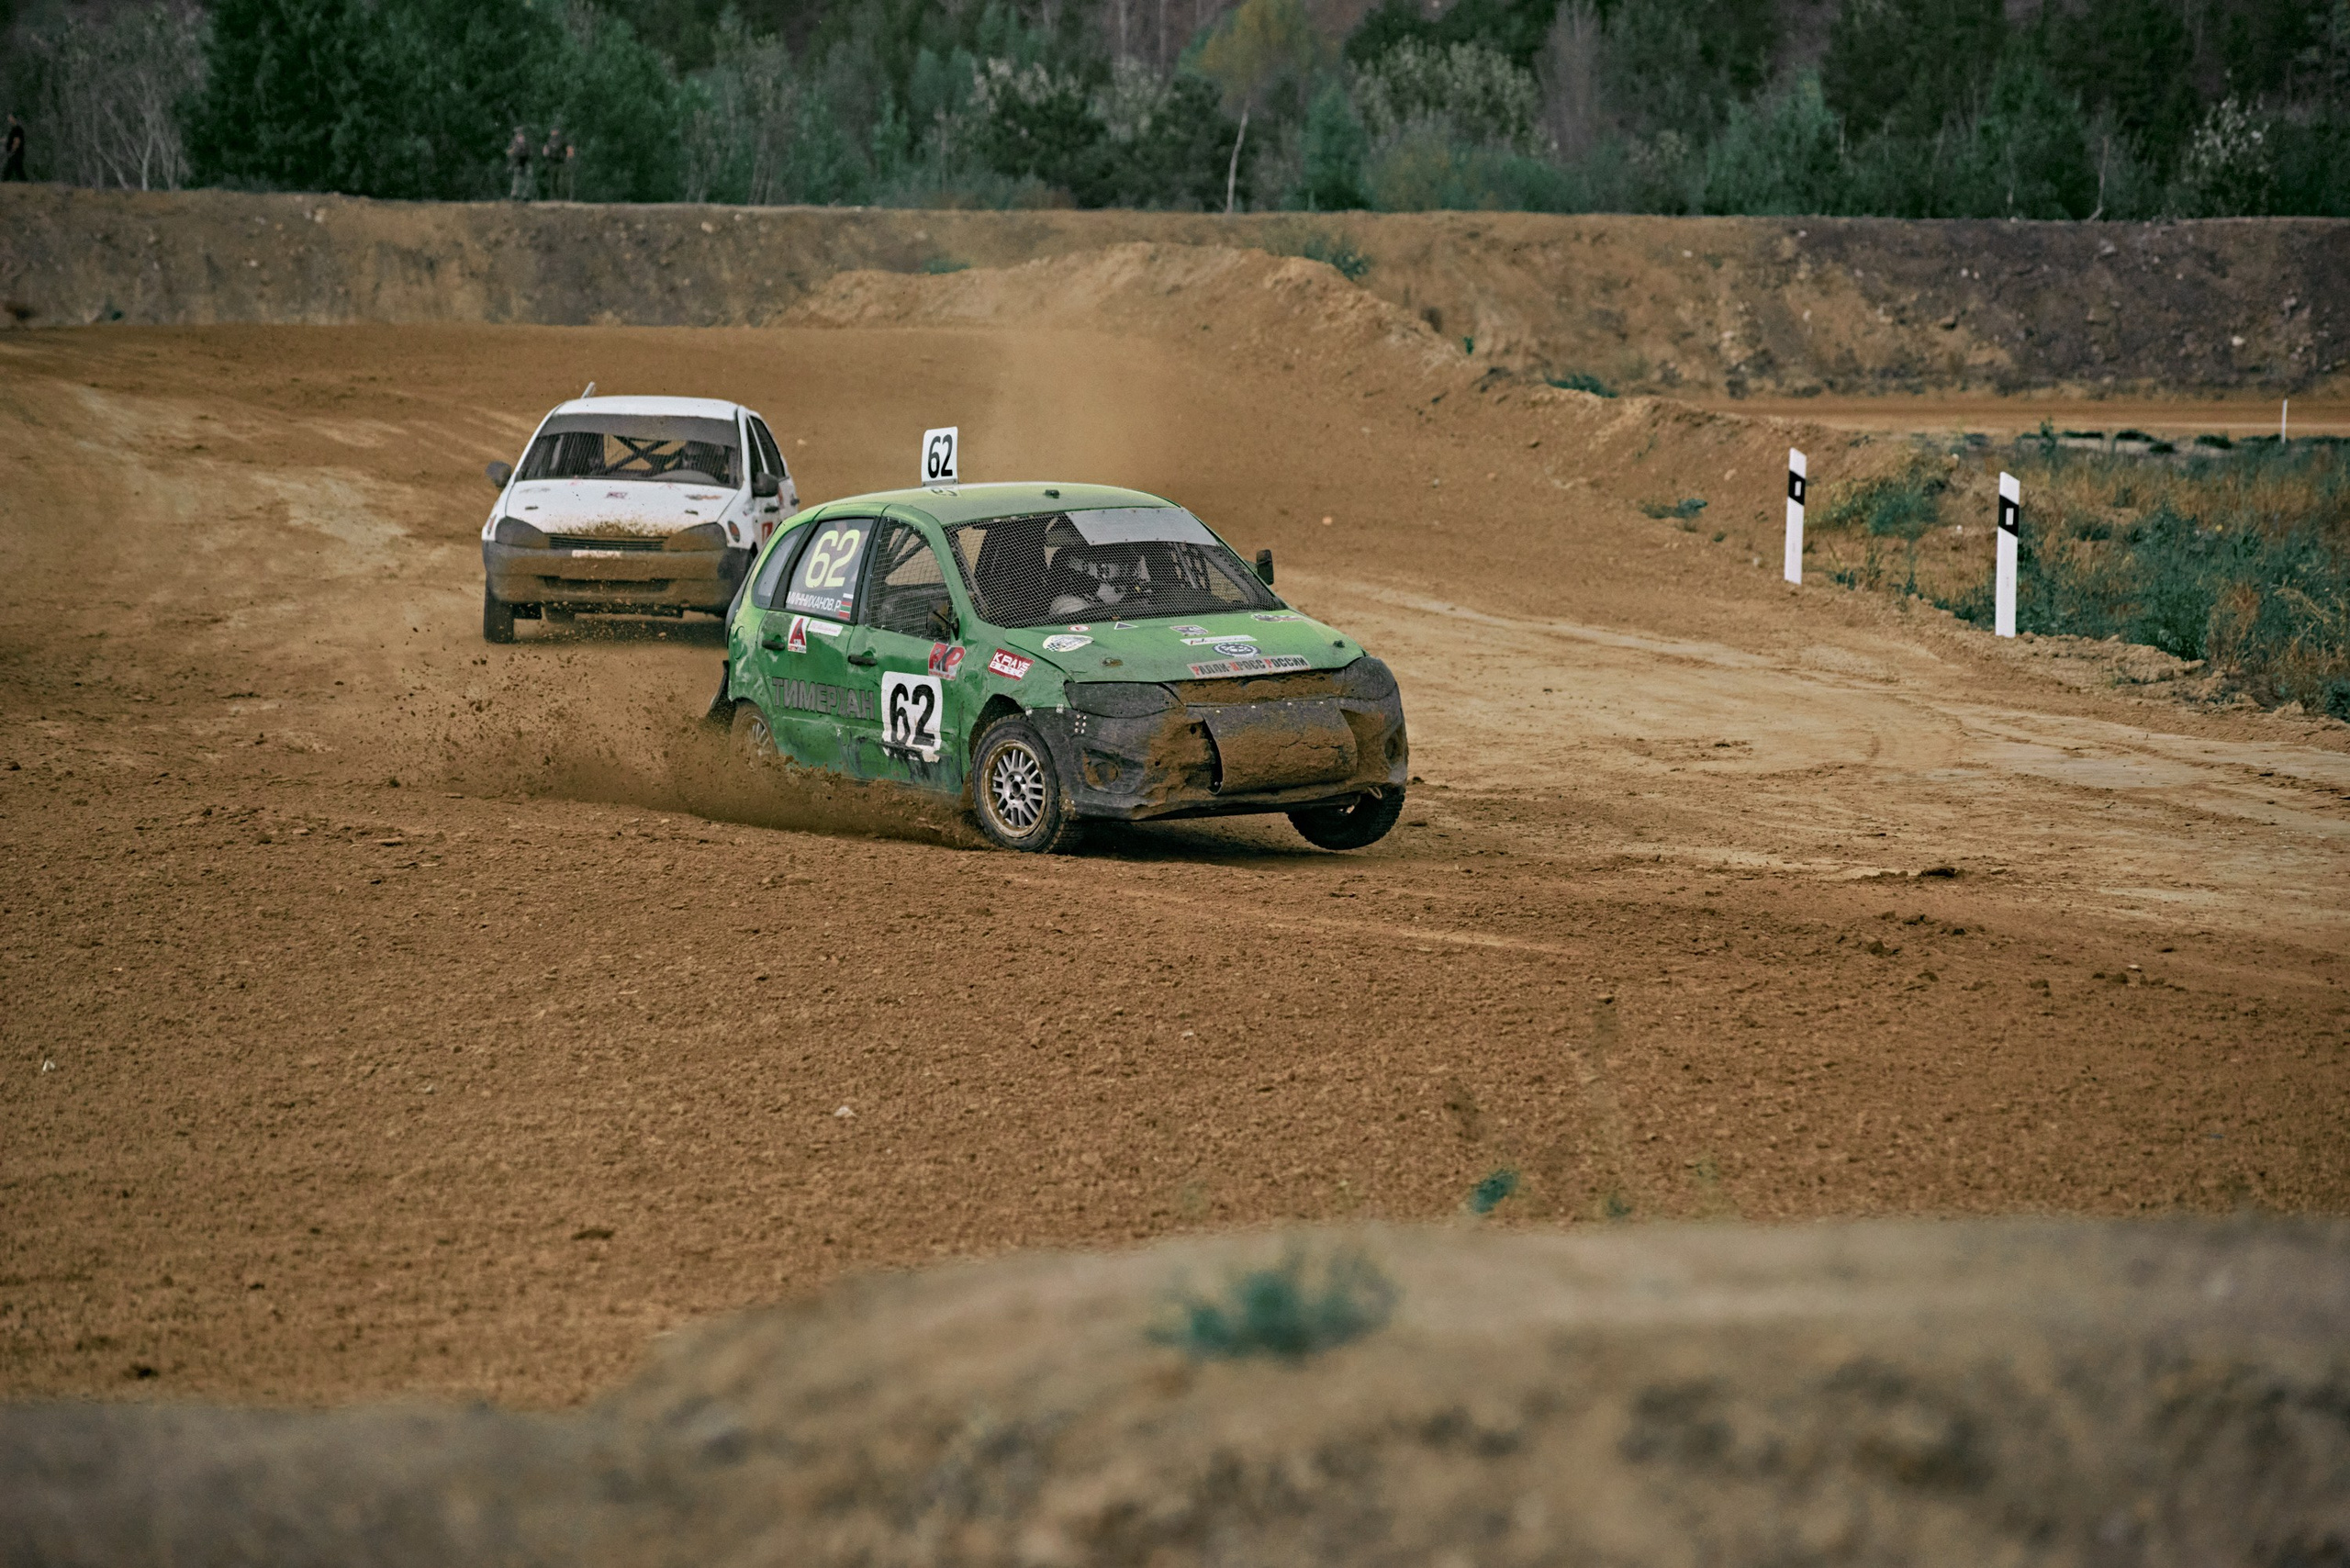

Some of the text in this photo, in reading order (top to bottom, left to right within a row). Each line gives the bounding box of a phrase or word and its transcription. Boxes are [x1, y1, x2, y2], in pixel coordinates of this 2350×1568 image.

[927, 433, 953, 478] 62
[805, 529, 860, 588] 62
[992, 652, 1030, 672] KRAYS
[1263, 656, 1308, 669] РОССИИ
[890, 682, 935, 747] 62
